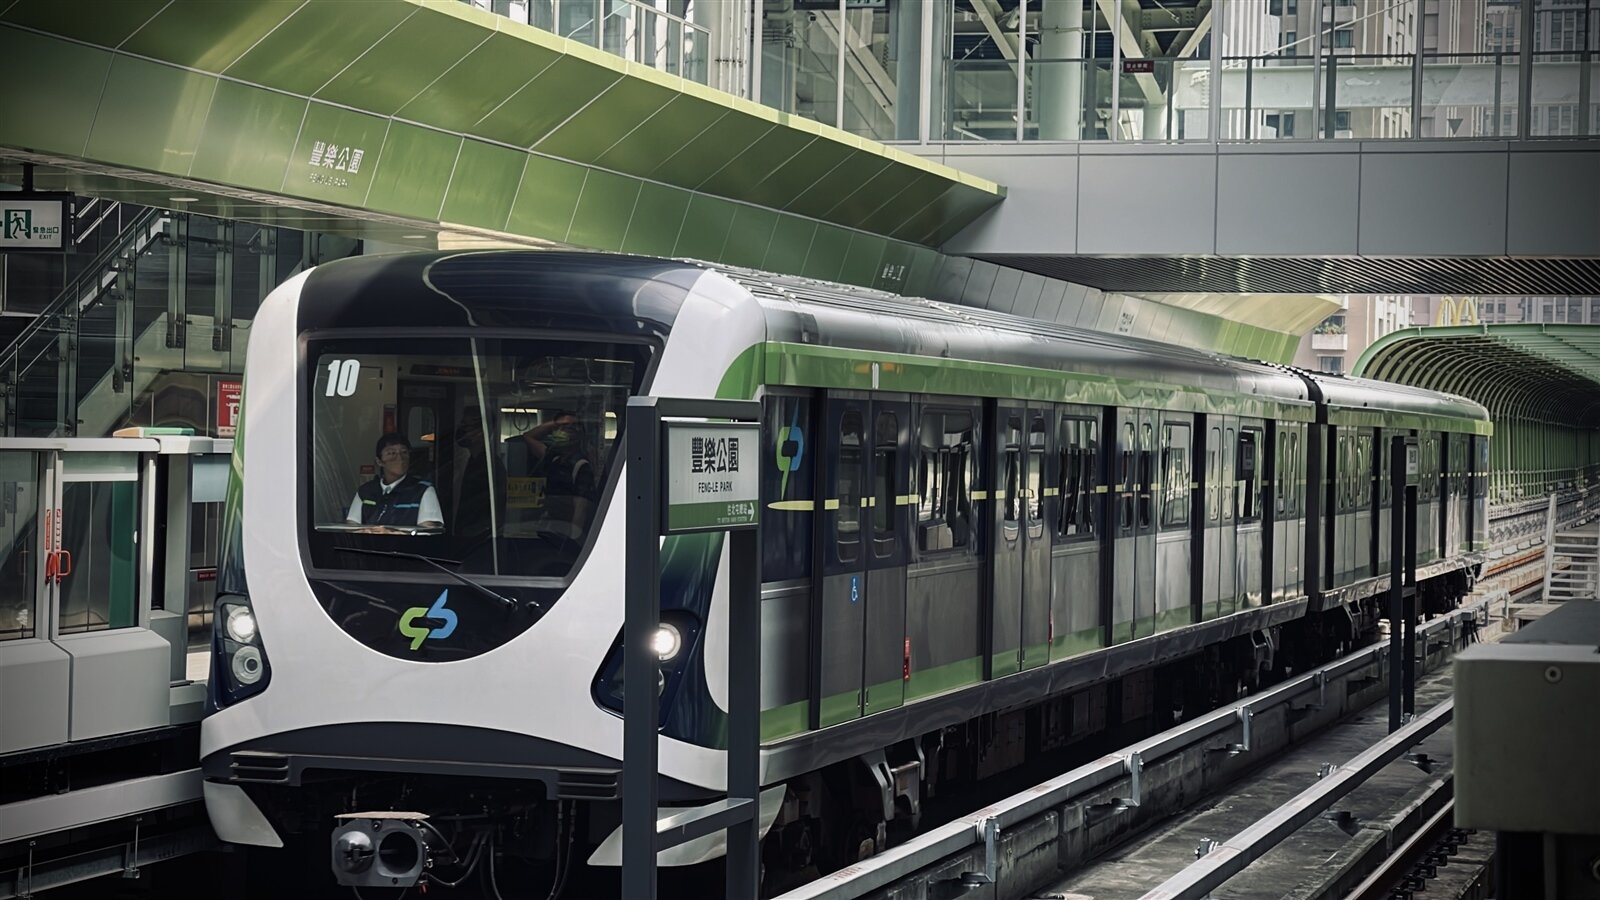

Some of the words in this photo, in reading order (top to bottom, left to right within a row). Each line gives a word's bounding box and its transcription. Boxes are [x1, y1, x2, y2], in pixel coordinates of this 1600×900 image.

[308, 140, 365, 174] 豐樂公園
[33, 226, 59, 234] 緊急出口
[325, 359, 361, 397] 10
[691, 437, 739, 474] 豐樂公園
[698, 481, 719, 493] FENG-LE
[720, 481, 733, 492] PARK
